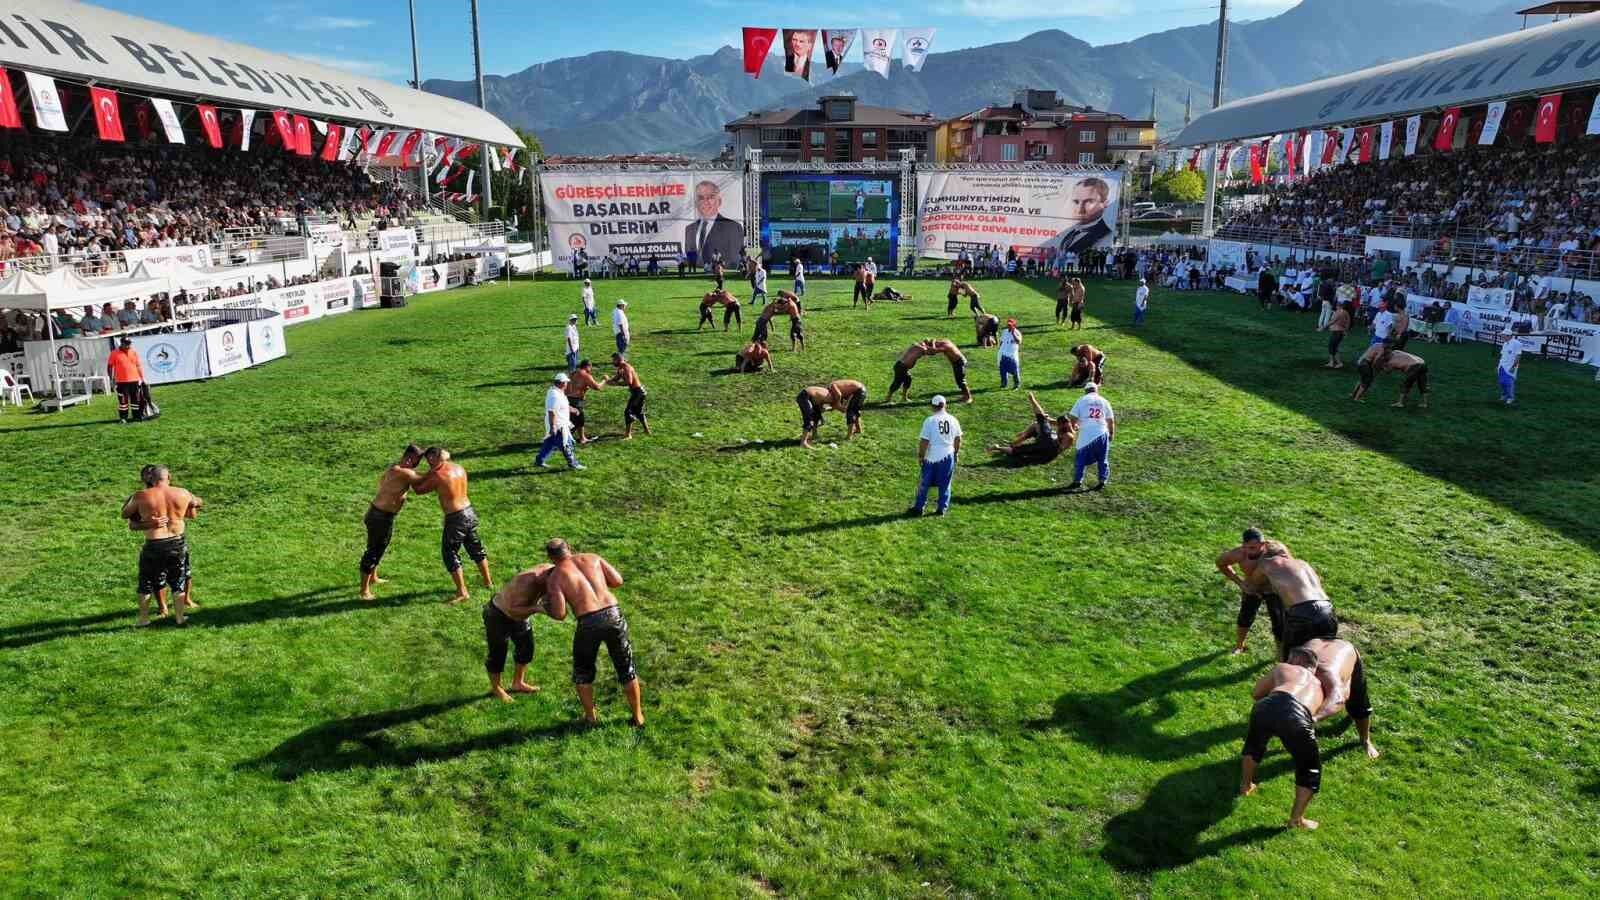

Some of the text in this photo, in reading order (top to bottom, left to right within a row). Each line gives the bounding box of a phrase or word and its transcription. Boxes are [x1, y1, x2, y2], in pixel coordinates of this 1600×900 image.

[111, 35, 363, 110] BELEDİYESİ
[555, 183, 686, 200] GÜREŞÇİLERİMİZE
[573, 202, 671, 217] BAŞARILAR
[990, 205, 1025, 215] SPORA
[977, 215, 1007, 224] OLAN
[591, 219, 658, 235] DİLERİM
[922, 223, 979, 232] DESTEĞİMİZ
[981, 225, 1018, 234] DEVAM
[648, 245, 679, 253] ZOLAN
[1089, 407, 1101, 419] 22
[938, 420, 950, 435] 60
